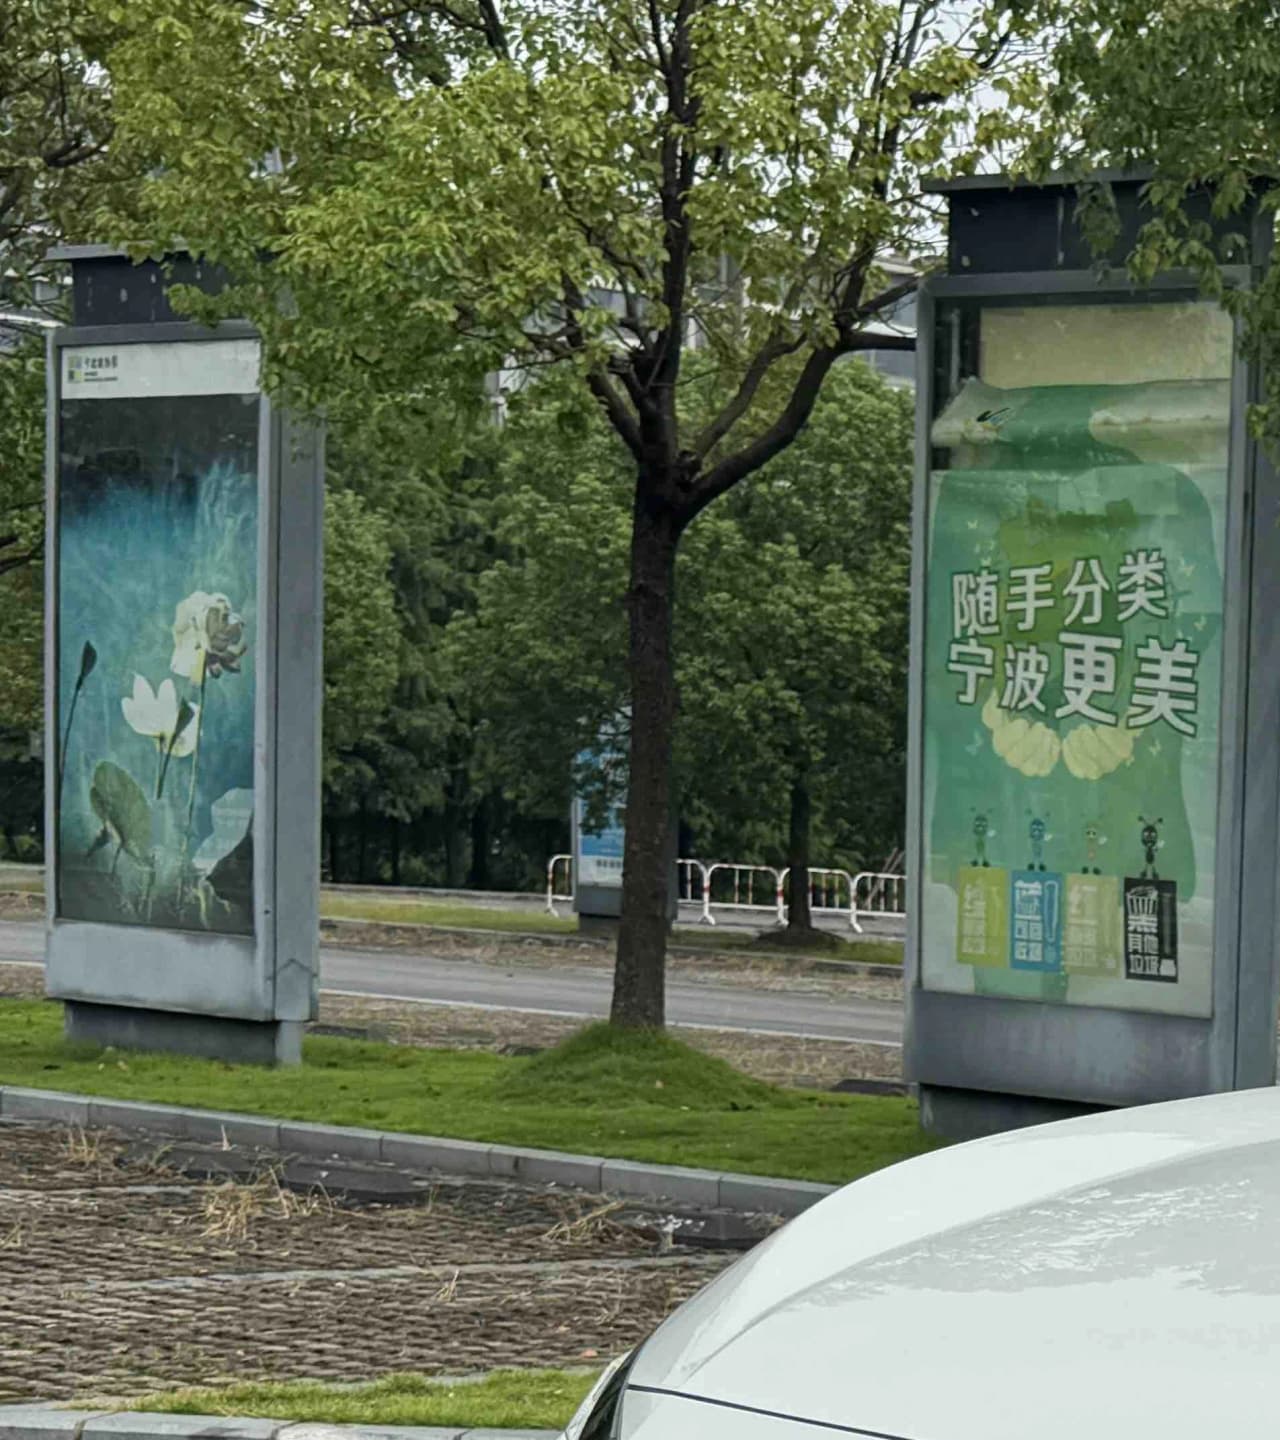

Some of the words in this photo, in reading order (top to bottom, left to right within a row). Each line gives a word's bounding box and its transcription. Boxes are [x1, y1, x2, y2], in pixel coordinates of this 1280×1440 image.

[953, 551, 1168, 638] 随手分类
[948, 632, 1198, 735] 宁波更美
